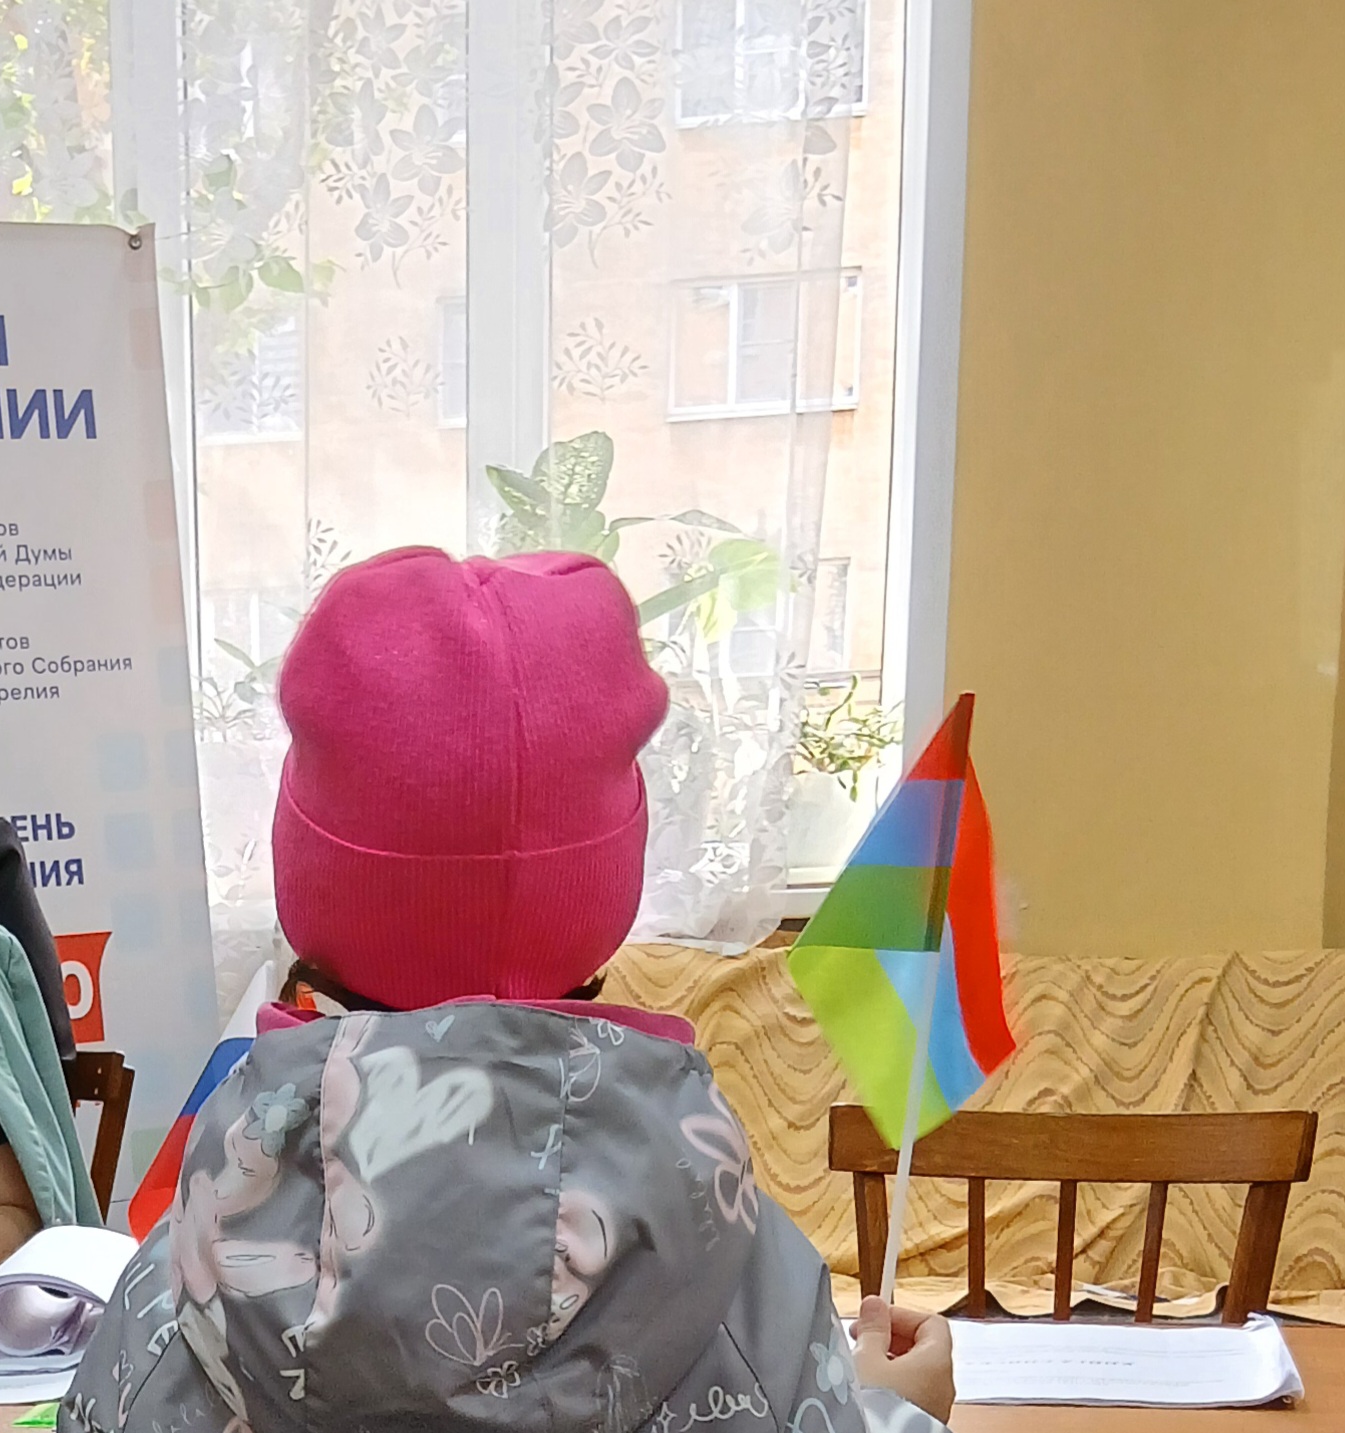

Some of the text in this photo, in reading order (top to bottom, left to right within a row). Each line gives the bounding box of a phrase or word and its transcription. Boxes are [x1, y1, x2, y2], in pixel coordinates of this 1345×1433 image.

[15, 544, 72, 567] Думы
[31, 655, 133, 680] Собрания
[11, 813, 75, 842] ЕНЬ
